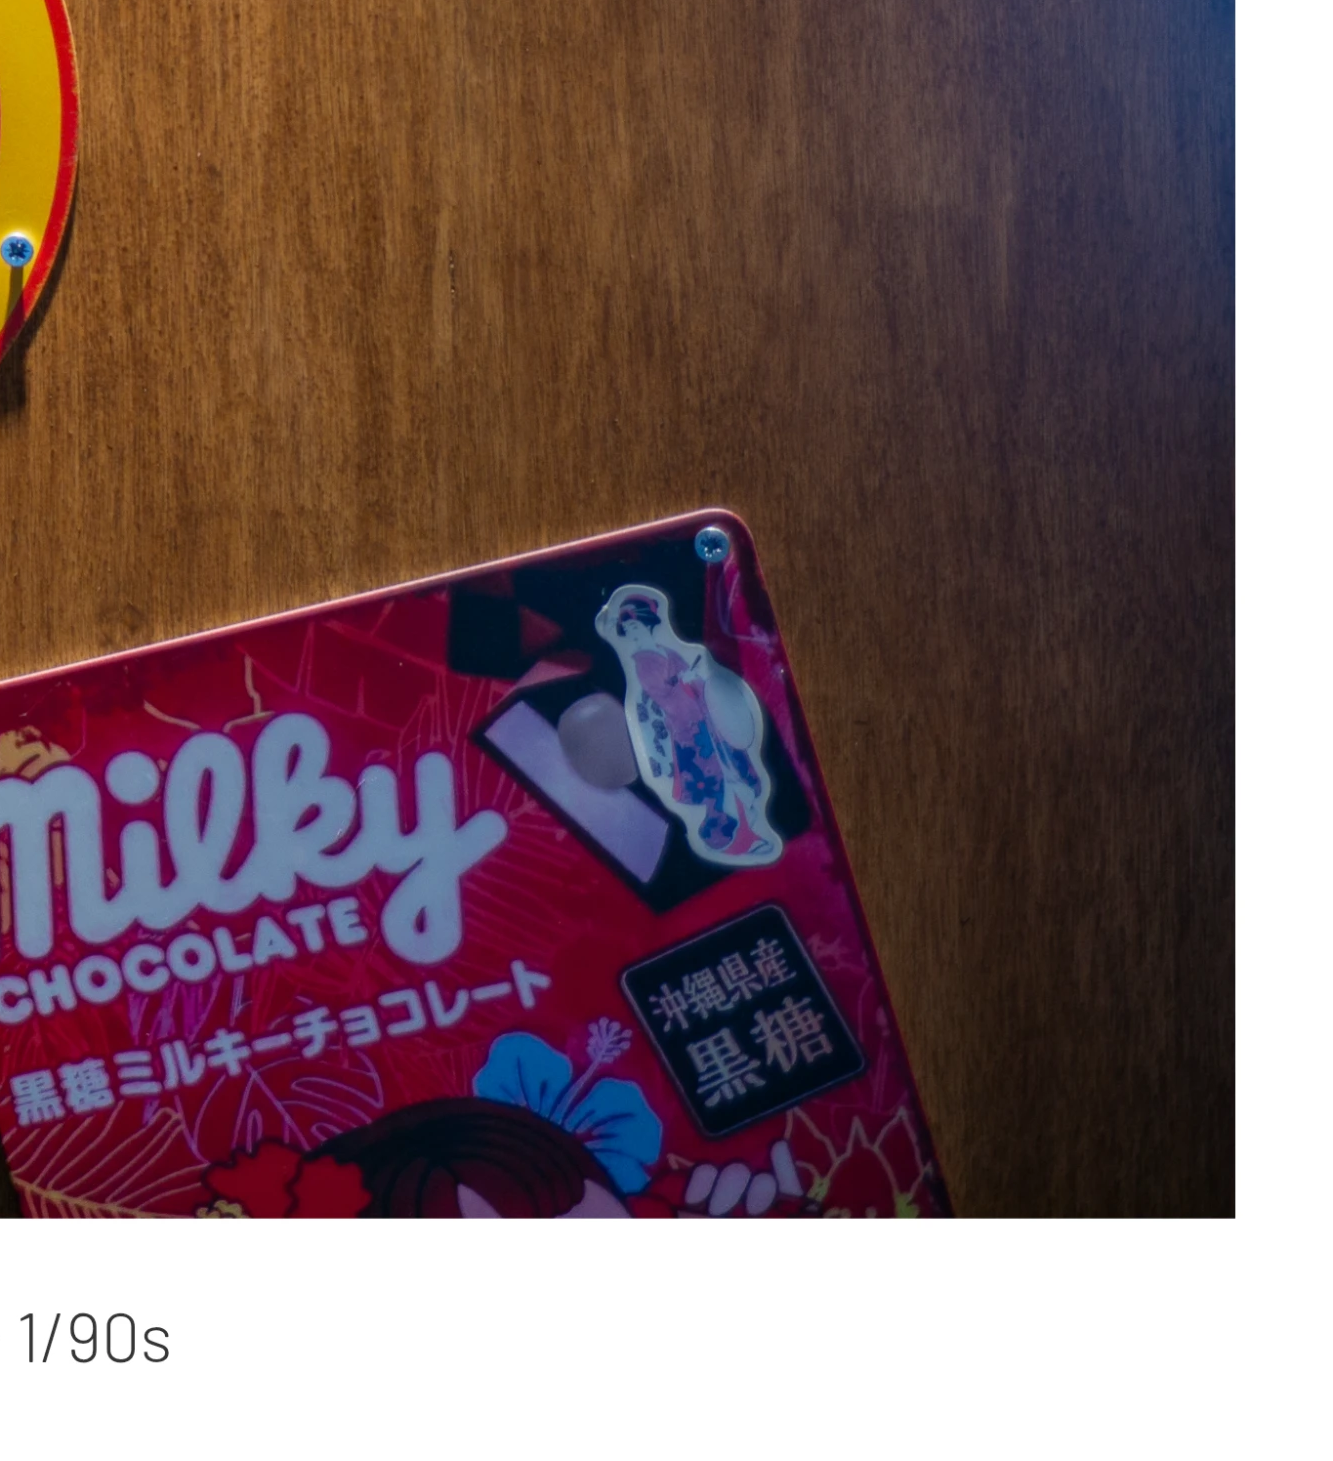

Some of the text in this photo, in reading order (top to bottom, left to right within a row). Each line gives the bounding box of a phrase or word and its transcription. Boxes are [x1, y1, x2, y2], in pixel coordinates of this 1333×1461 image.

[648, 937, 797, 1033] 沖縄県産
[8, 958, 552, 1127] 黒糖ミルキーチョコレート
[686, 996, 834, 1108] 黒糖
